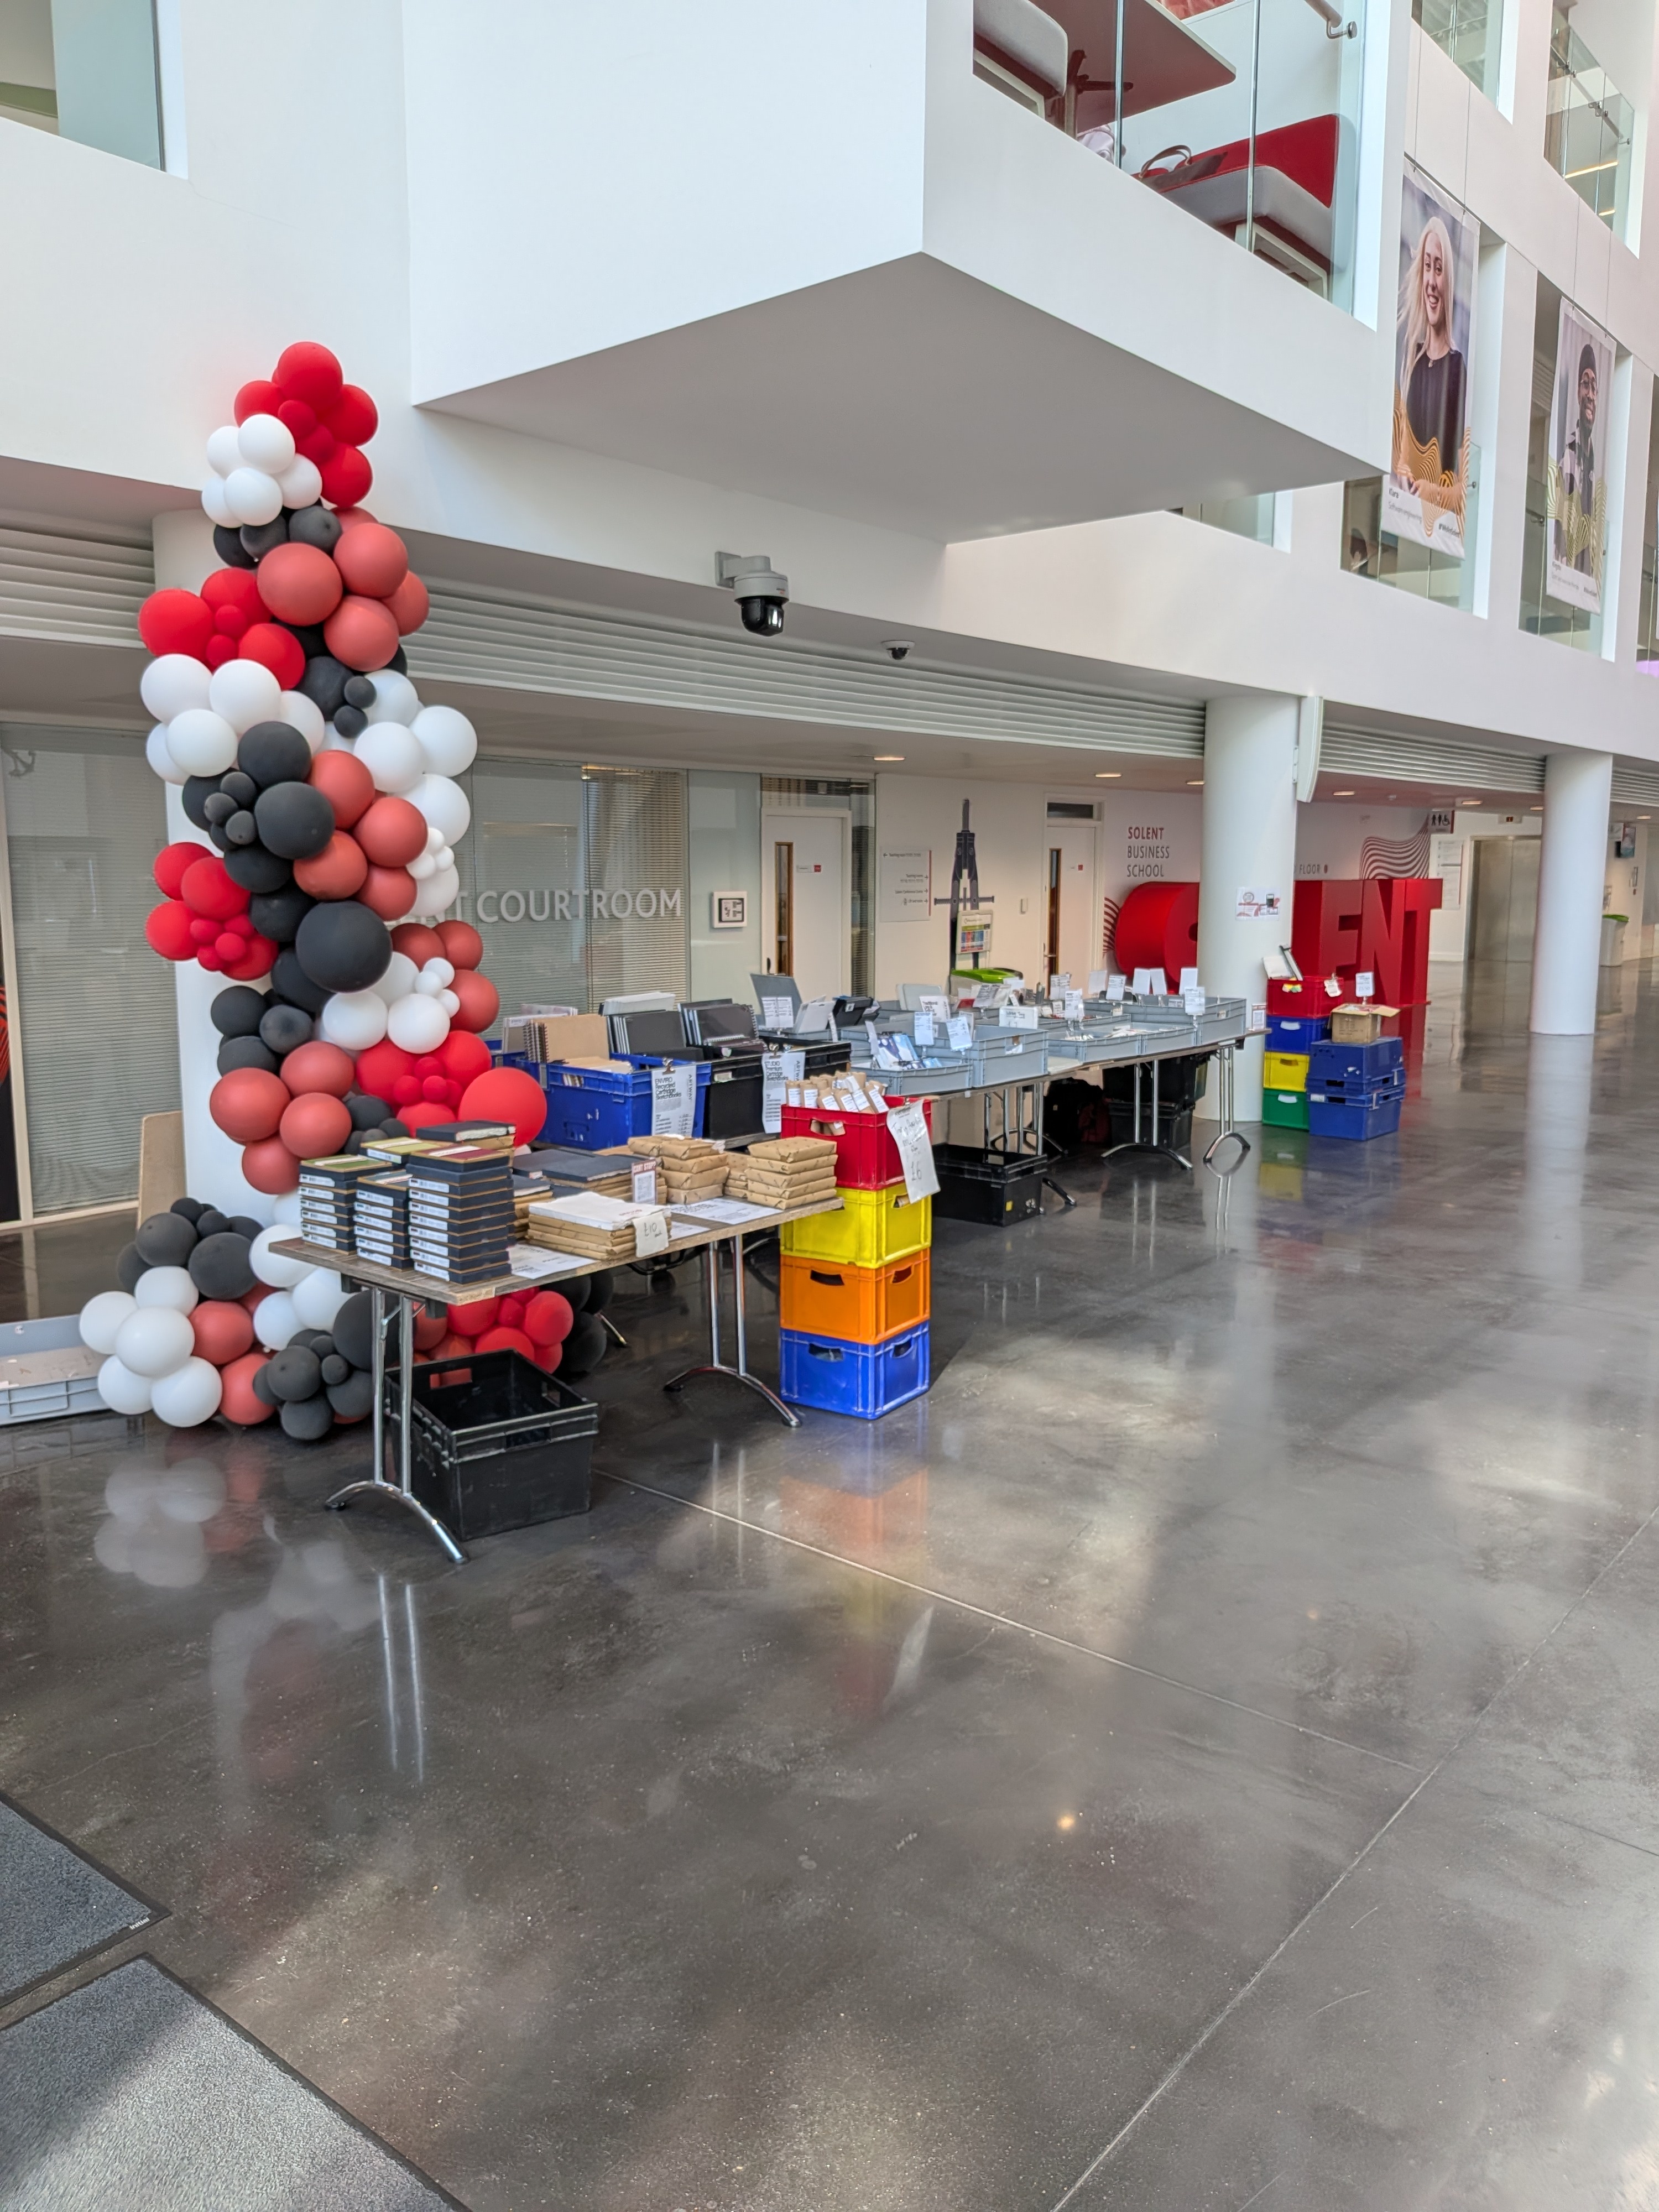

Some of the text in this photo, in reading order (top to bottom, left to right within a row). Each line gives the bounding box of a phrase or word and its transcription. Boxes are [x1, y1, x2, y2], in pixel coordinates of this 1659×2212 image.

[1128, 826, 1164, 840] SOLENT
[1128, 845, 1170, 859] BUSINESS
[1126, 864, 1164, 878] SCHOOL
[1299, 864, 1320, 874] FLOOR
[476, 889, 681, 923] COURTROOM
[655, 1082, 676, 1090] Recycled
[644, 1222, 657, 1237] £10
